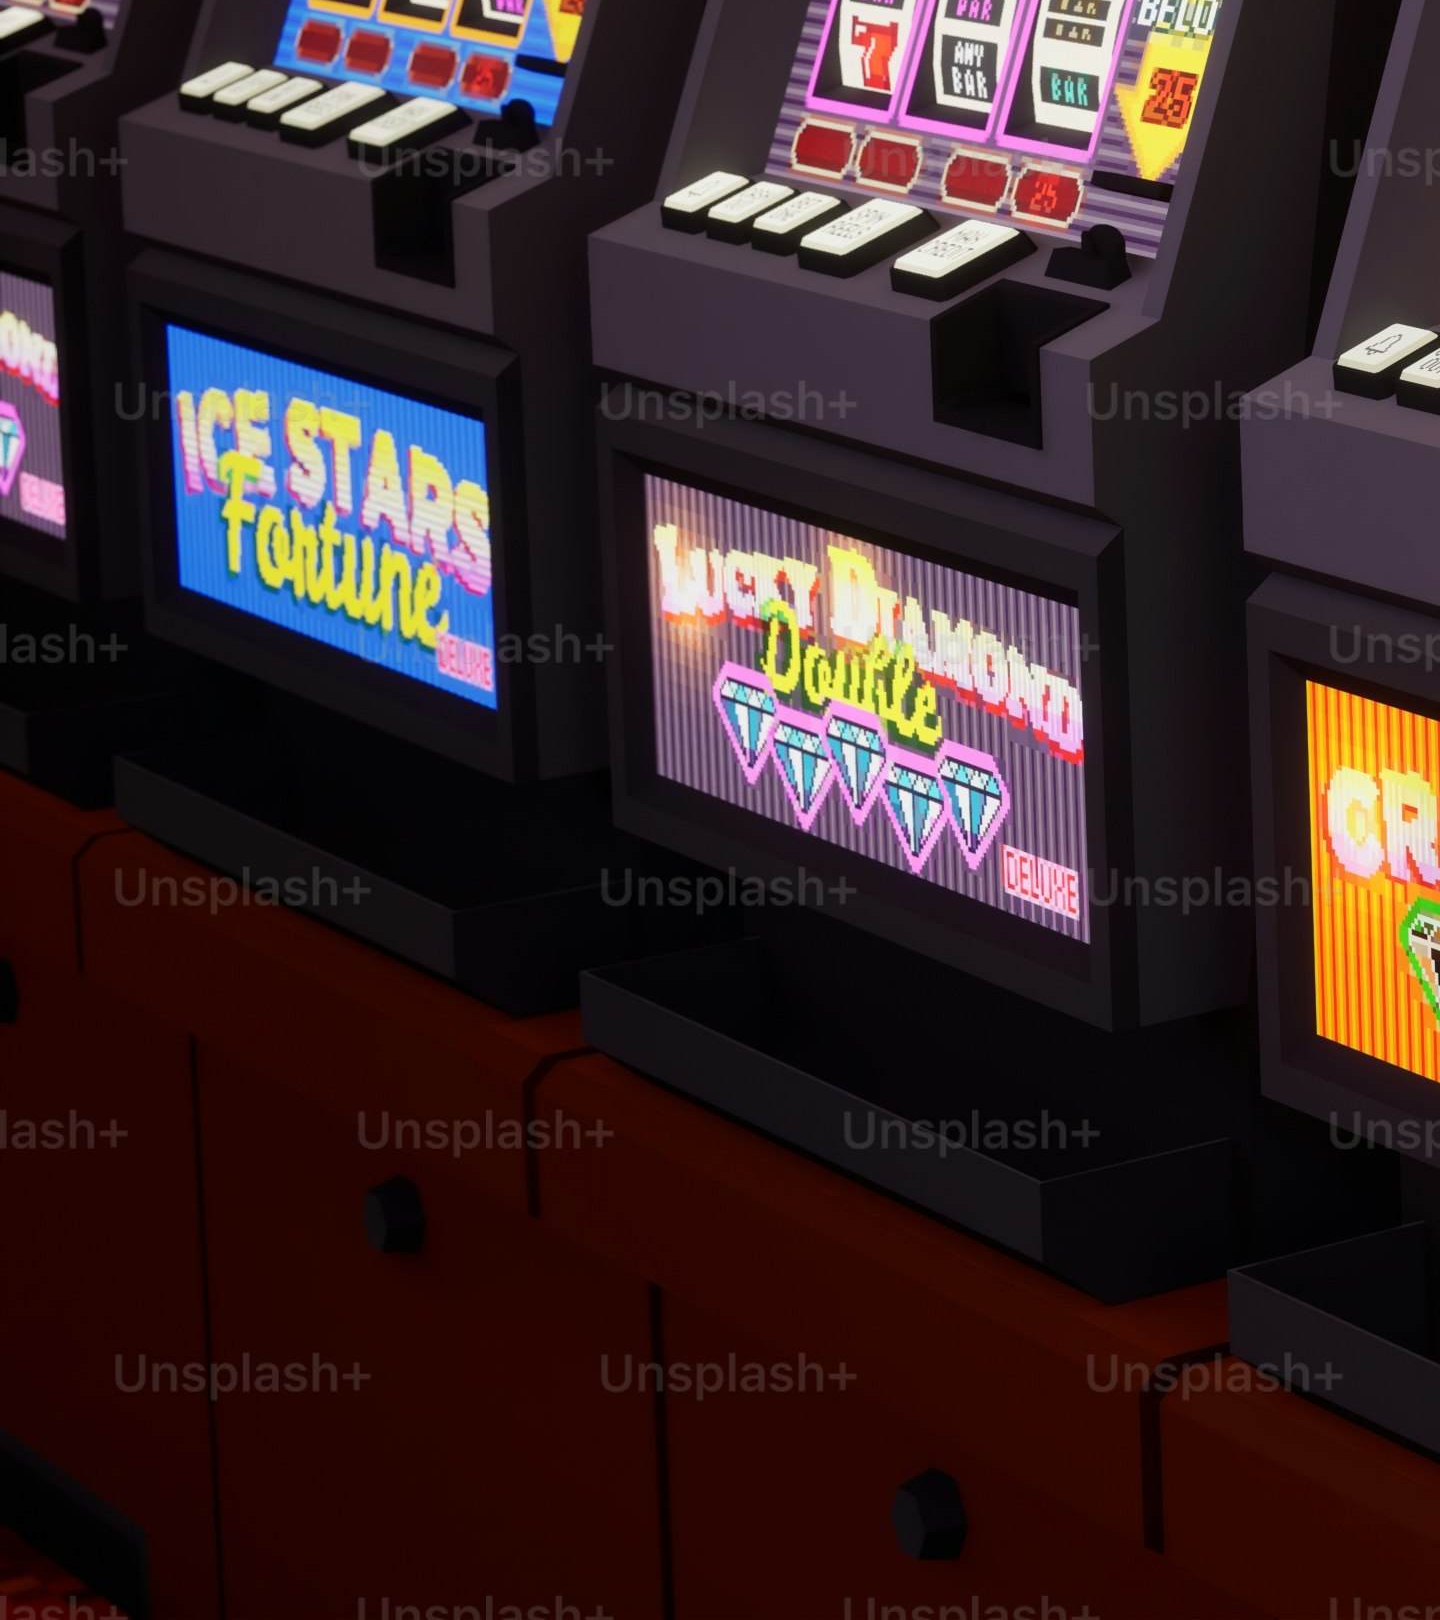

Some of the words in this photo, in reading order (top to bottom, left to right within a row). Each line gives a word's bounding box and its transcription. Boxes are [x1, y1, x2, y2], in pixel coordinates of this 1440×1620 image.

[1140, 67, 1199, 129] 25
[177, 387, 276, 497] ICE
[285, 397, 492, 596] STARS
[219, 449, 449, 650] Fortune
[760, 598, 942, 747] Double
[827, 545, 1084, 766] DIAMOND
[1003, 849, 1079, 916] DELUXE
